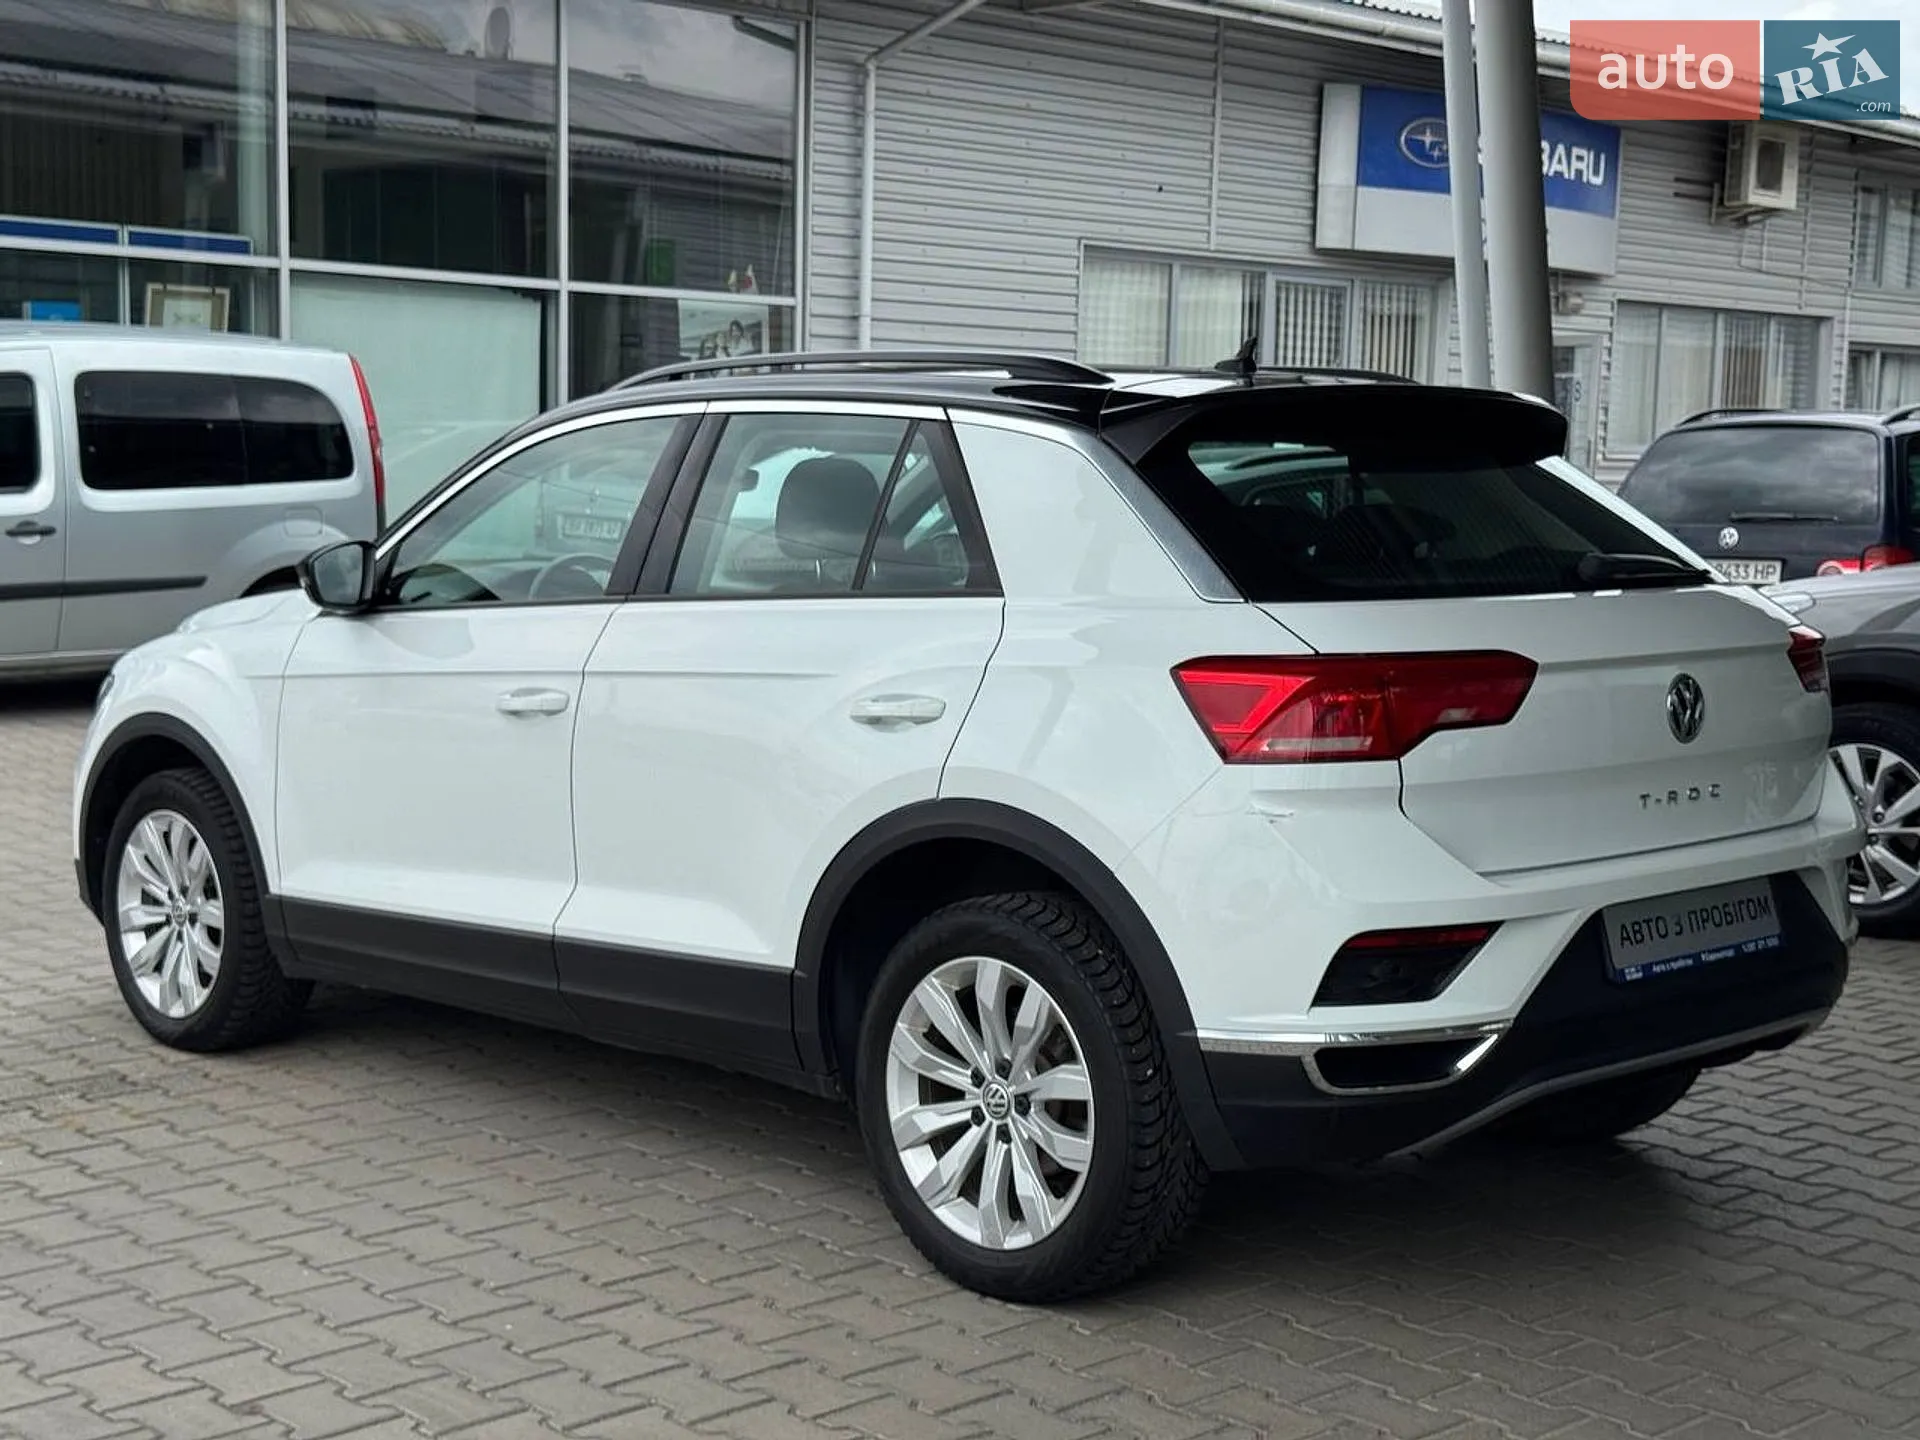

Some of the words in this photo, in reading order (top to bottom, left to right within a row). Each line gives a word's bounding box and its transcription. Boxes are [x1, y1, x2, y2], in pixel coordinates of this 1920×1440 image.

[1639, 783, 1721, 810] T-ROC
[1619, 915, 1669, 949] АВТО
[1687, 895, 1772, 934] ПРОБІГОМ
